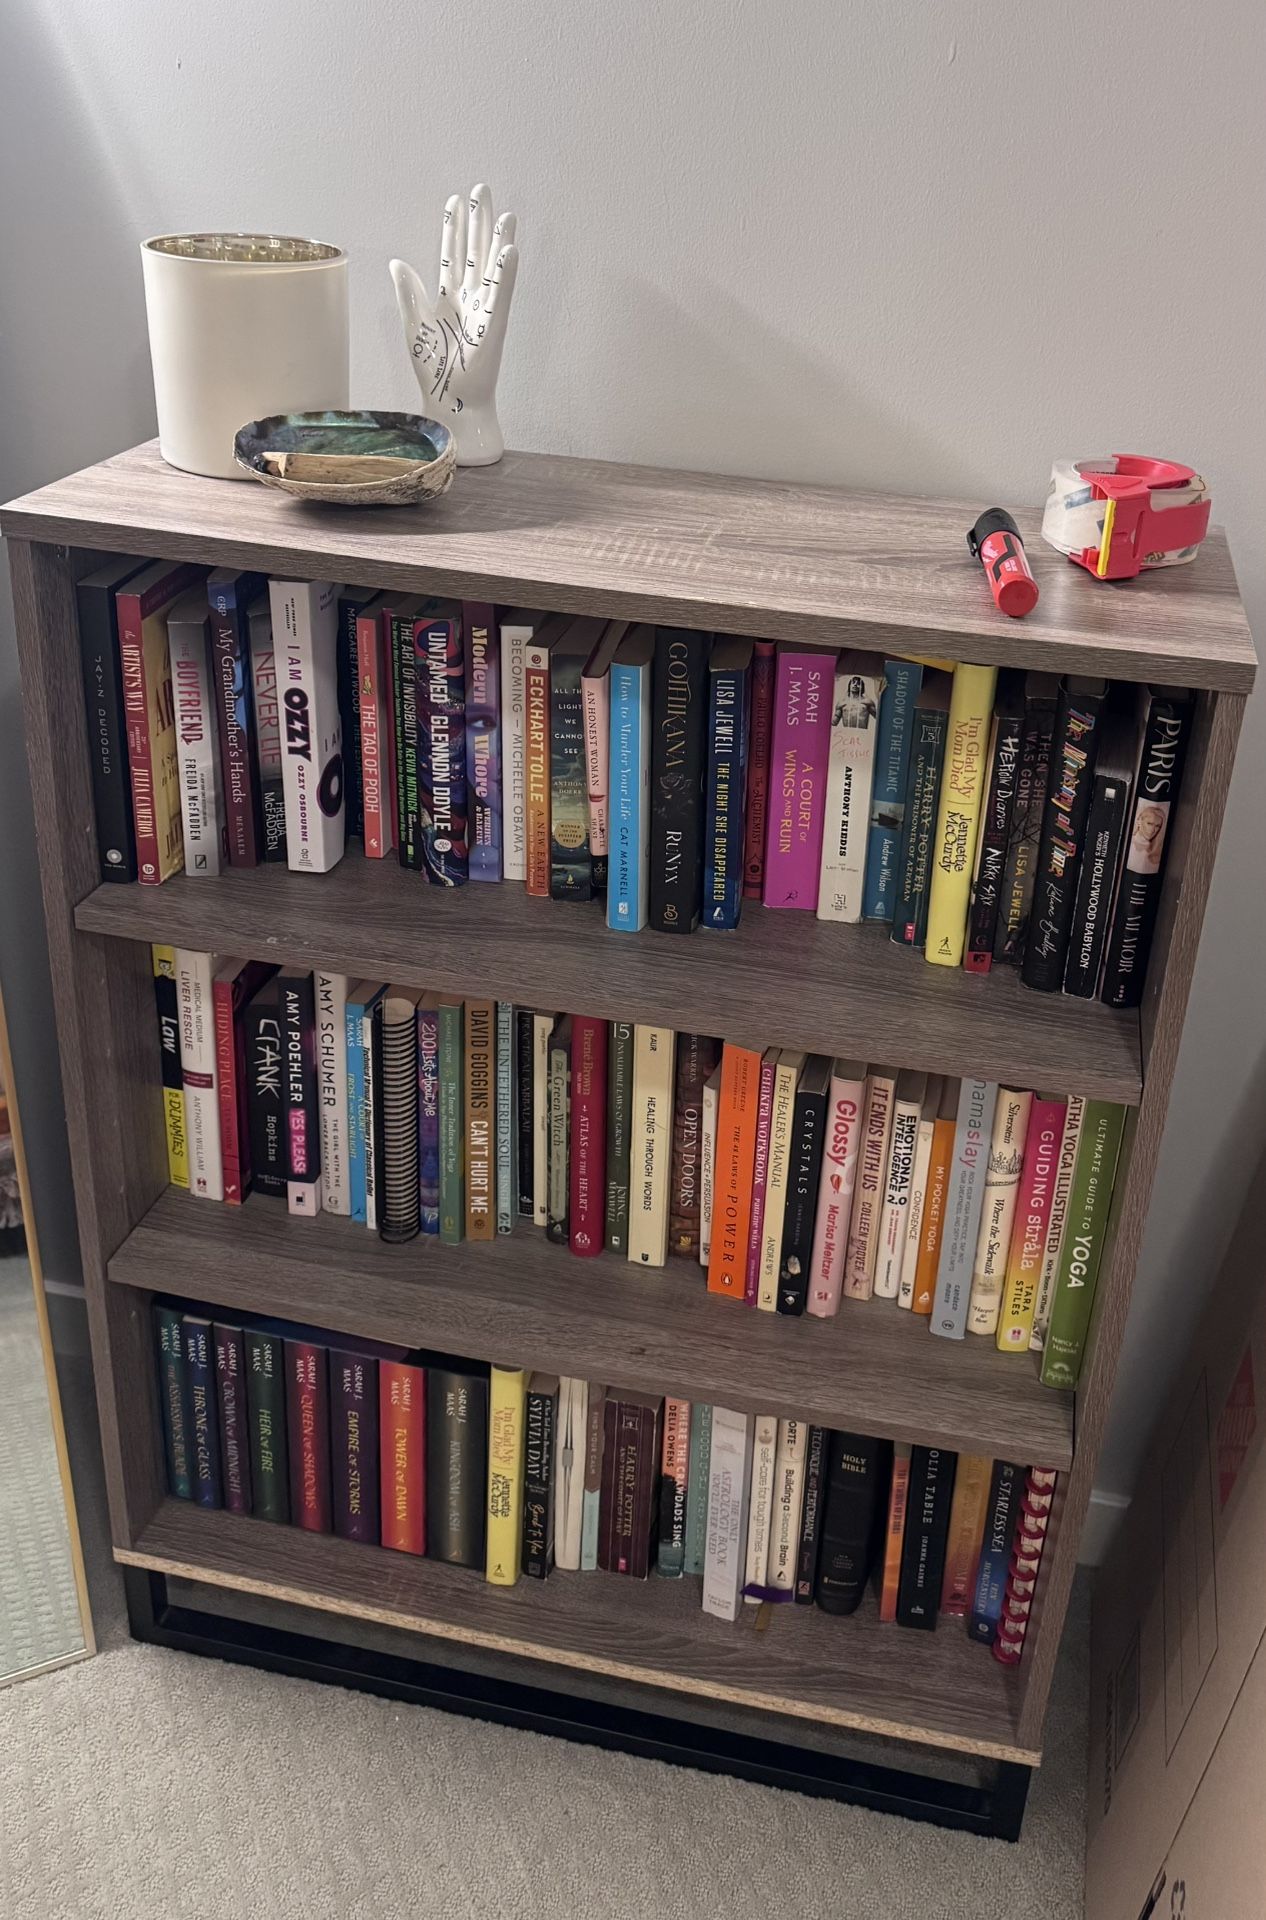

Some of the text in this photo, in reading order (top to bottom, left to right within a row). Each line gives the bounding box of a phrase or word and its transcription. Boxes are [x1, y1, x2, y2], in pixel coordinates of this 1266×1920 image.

[400, 623, 418, 812] THE ART OF INVISIBILITY KEVIN MITNICK
[428, 632, 451, 831] UNTAMED GLENNON DOYLE
[714, 680, 735, 754] LISA JEWELL
[805, 671, 820, 722] SARAH
[362, 704, 379, 812] THE TAO OF POOH
[530, 676, 544, 802] ECKHART TOLLE
[587, 691, 600, 786] AN HONEST WOMAN
[916, 754, 925, 774] AND
[1145, 716, 1182, 793] PARIS
[132, 767, 152, 839] JULIA CAMERON
[297, 765, 309, 842] OZZY OSBOURNE
[839, 766, 853, 857] ANTHONY KIEDIS
[914, 777, 923, 797] THE
[537, 809, 546, 889] A NEW EARTH
[619, 827, 629, 896] CAT MARNELL
[713, 762, 730, 900] THE NIGHT SHE DISAPPEARED
[908, 843, 917, 858] OF
[954, 813, 972, 872] Jennette
[1101, 830, 1110, 858] KENNETH
[1007, 846, 1027, 932] LISA JEWELL
[1079, 858, 1105, 968] HOLLYWOOD BABYLON
[181, 971, 193, 1050] LIVER RESCUE
[194, 982, 202, 1012] MEDICAL
[161, 1016, 178, 1054] Law
[286, 991, 302, 1102] AMY POEHLER
[319, 976, 336, 1107] AMY SCHUMER
[471, 1010, 488, 1109] DAVID GOGGINS
[583, 1028, 593, 1095] Brené Brown
[649, 1034, 658, 1052] KAUR
[168, 1100, 184, 1156] DUMMIES
[193, 1096, 205, 1170] ANTHONY WILLIAM
[290, 1110, 306, 1174] YES PLEASE
[643, 1096, 656, 1211] HEALING THROUGH WORDS
[680, 1108, 698, 1207] OPEN DOORS
[771, 1074, 791, 1188] THE HEALER'S MANUAL
[798, 1109, 815, 1194] CRYSTALS
[827, 1100, 857, 1167] Glossy
[863, 1086, 888, 1191] IT ENDS WITH US
[889, 1113, 906, 1191] INTELLIGENCE
[898, 1115, 916, 1192] EMOTIONAL
[1003, 1102, 1021, 1144] Silverstein
[471, 1121, 488, 1213] CAN'T HURT ME
[579, 1115, 589, 1211] ATLAS OF THE HEART
[926, 1166, 945, 1252] MY POCKET YOGA
[1067, 1118, 1108, 1289] ULTIMATE GUIDE TO YOGA
[820, 1204, 840, 1280] Marisa Meltzer
[1010, 1280, 1024, 1316] STILES
[1022, 1284, 1034, 1312] TARA
[160, 1327, 170, 1351] MAAS
[187, 1338, 196, 1362] MAAS
[217, 1345, 227, 1370] MAAS
[252, 1347, 261, 1372] MAAS
[296, 1359, 305, 1383] MAAS
[343, 1368, 352, 1393] MAAS
[390, 1380, 399, 1405] MAAS
[446, 1392, 456, 1416] MAAS
[193, 1385, 210, 1481] THRONE OF GLASS
[258, 1409, 273, 1473] HEIR OF FIRE
[300, 1394, 316, 1509] QUEEN OF SHADOWS
[347, 1410, 361, 1515] EMPIRE OF STORMS
[492, 1407, 504, 1461] Mom Died
[501, 1406, 515, 1466] I'm Glad My
[528, 1397, 542, 1479] SYLVIA DAY
[666, 1405, 676, 1467] DELIA OWENS
[841, 1463, 867, 1474] BIBLE
[395, 1427, 407, 1521] TOWER OF DAWN
[488, 1472, 501, 1519] McCurdy
[501, 1475, 513, 1517] Jennette
[623, 1445, 636, 1537] HARRY POTTER
[672, 1404, 688, 1548] WHERE THE CRAWDADS SING
[717, 1467, 732, 1567] ASTROLOGY BOOK
[991, 1480, 1012, 1553] STARLESS SEA
